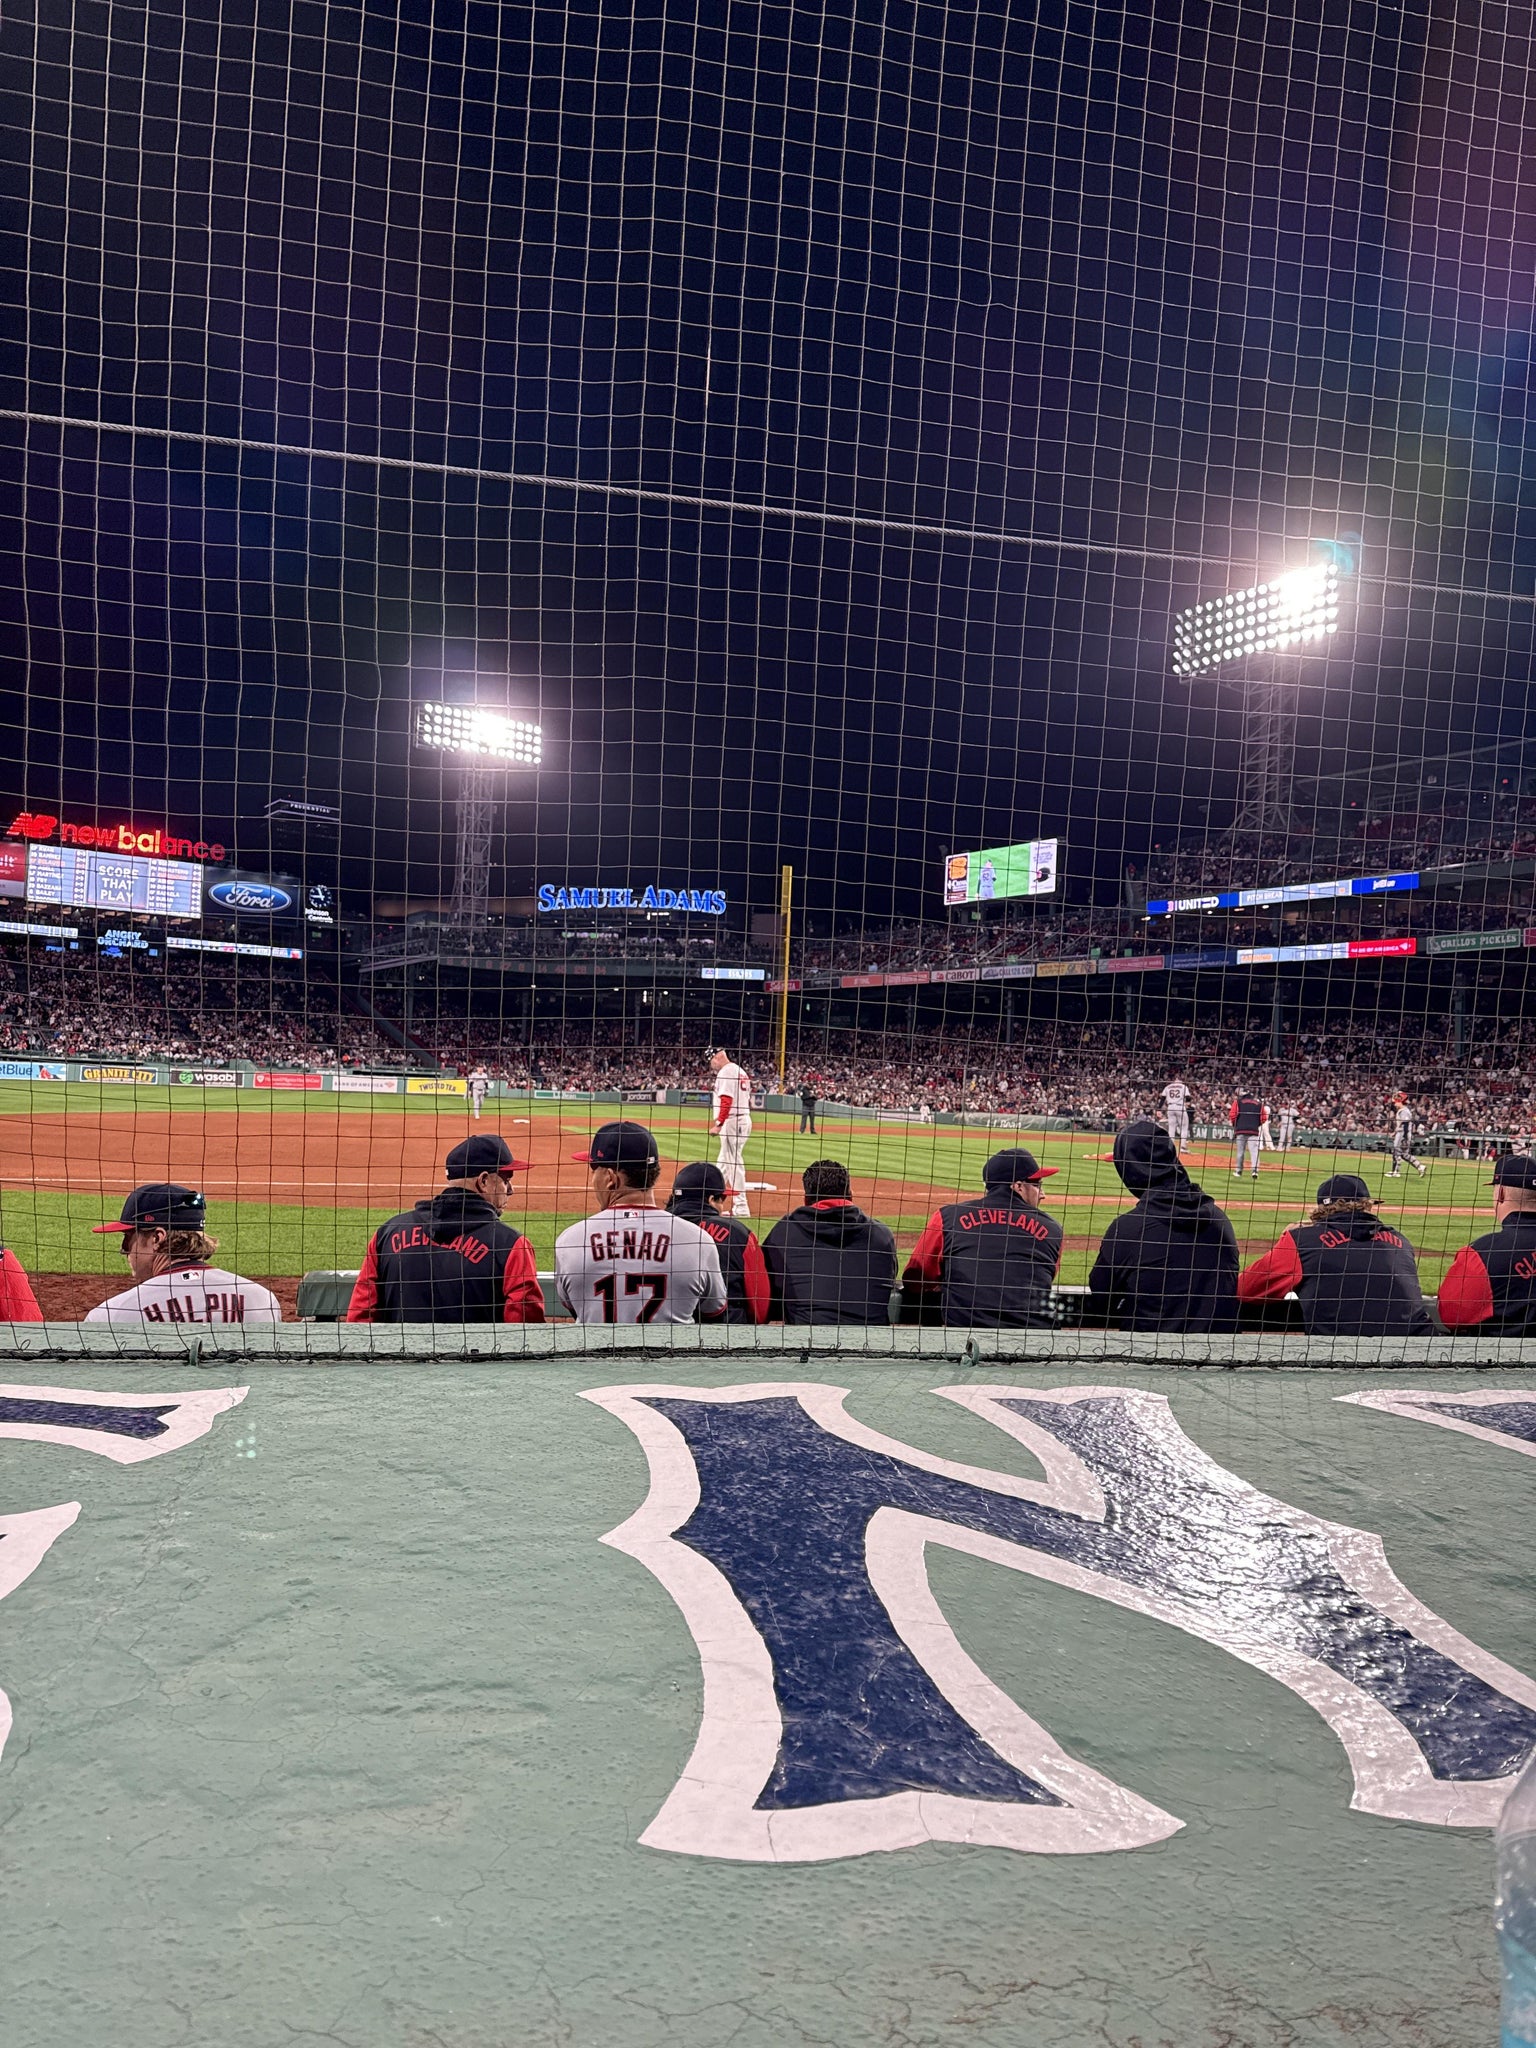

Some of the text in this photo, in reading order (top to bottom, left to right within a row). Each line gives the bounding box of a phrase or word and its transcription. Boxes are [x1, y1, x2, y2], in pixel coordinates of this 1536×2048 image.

[290, 803, 330, 814] PRUDENTIAL
[98, 865, 140, 880] SCORE
[102, 877, 134, 891] THAT
[100, 890, 135, 903] PLAY
[225, 884, 276, 908] Ford
[538, 884, 727, 915] SAMUEL ADAMS
[1178, 896, 1220, 911] UNITED
[304, 907, 330, 917] Johnson
[307, 914, 334, 924] Controls
[104, 929, 142, 940] ANGRY
[1440, 934, 1517, 948] GRILLO'S PICKLES
[97, 936, 149, 949] ORCHARD
[83, 1067, 156, 1082] GRANITE CITY
[194, 1071, 237, 1082] wasabi
[419, 1083, 457, 1093] TWISTED TEA
[1169, 1089, 1181, 1099] 62
[960, 1209, 1049, 1241] CLEVELAND
[391, 1226, 489, 1264] CLEVAND
[590, 1230, 671, 1263] GENAO
[593, 1272, 668, 1324] 17
[143, 1292, 245, 1323] HALPIN
